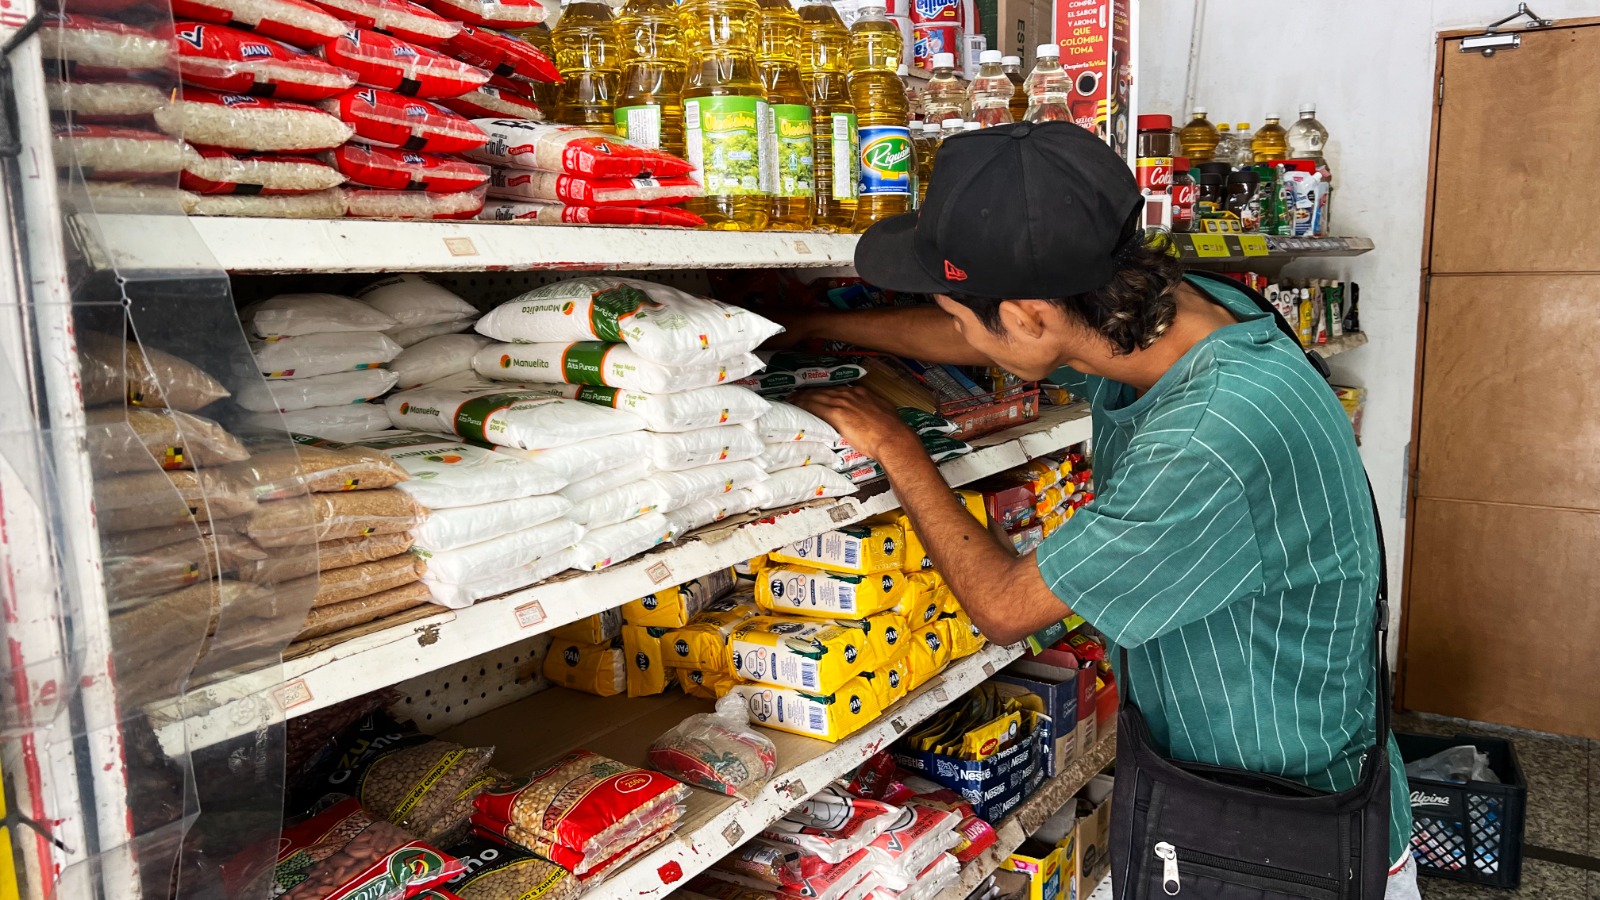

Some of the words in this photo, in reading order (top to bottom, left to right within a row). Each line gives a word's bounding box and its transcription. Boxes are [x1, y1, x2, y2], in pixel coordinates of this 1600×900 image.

[1076, 8, 1098, 17] SABOR
[1073, 18, 1097, 26] AROMA
[1073, 27, 1091, 36] QUE
[1060, 35, 1104, 47] COLOMBIA
[241, 45, 272, 57] DIANA
[1070, 46, 1094, 55] TOMA
[521, 301, 561, 314] Manuelita
[513, 358, 549, 369] Manuelita
[567, 362, 579, 370] Alta
[579, 363, 599, 372] Pureza
[581, 392, 592, 400] Alta
[592, 394, 611, 402] Pureza
[410, 405, 440, 417] Manuelita
[883, 540, 895, 551] PAN
[773, 578, 782, 598] PAN
[882, 578, 894, 590] PAN
[642, 596, 658, 607] PAN
[886, 632, 898, 641] PAN
[675, 644, 689, 653] PAN
[844, 648, 857, 661] PAN
[639, 652, 647, 671] PAN
[850, 699, 861, 710] PAN
[896, 754, 924, 770] Nestlé
[1011, 750, 1029, 767] Nestlé
[414, 785, 425, 798] del
[424, 764, 446, 786] campo
[960, 768, 991, 782] Nestlé
[984, 782, 1005, 802] Nestlé
[1002, 792, 1021, 812] Nestlé
[1409, 791, 1450, 806] Alpina
